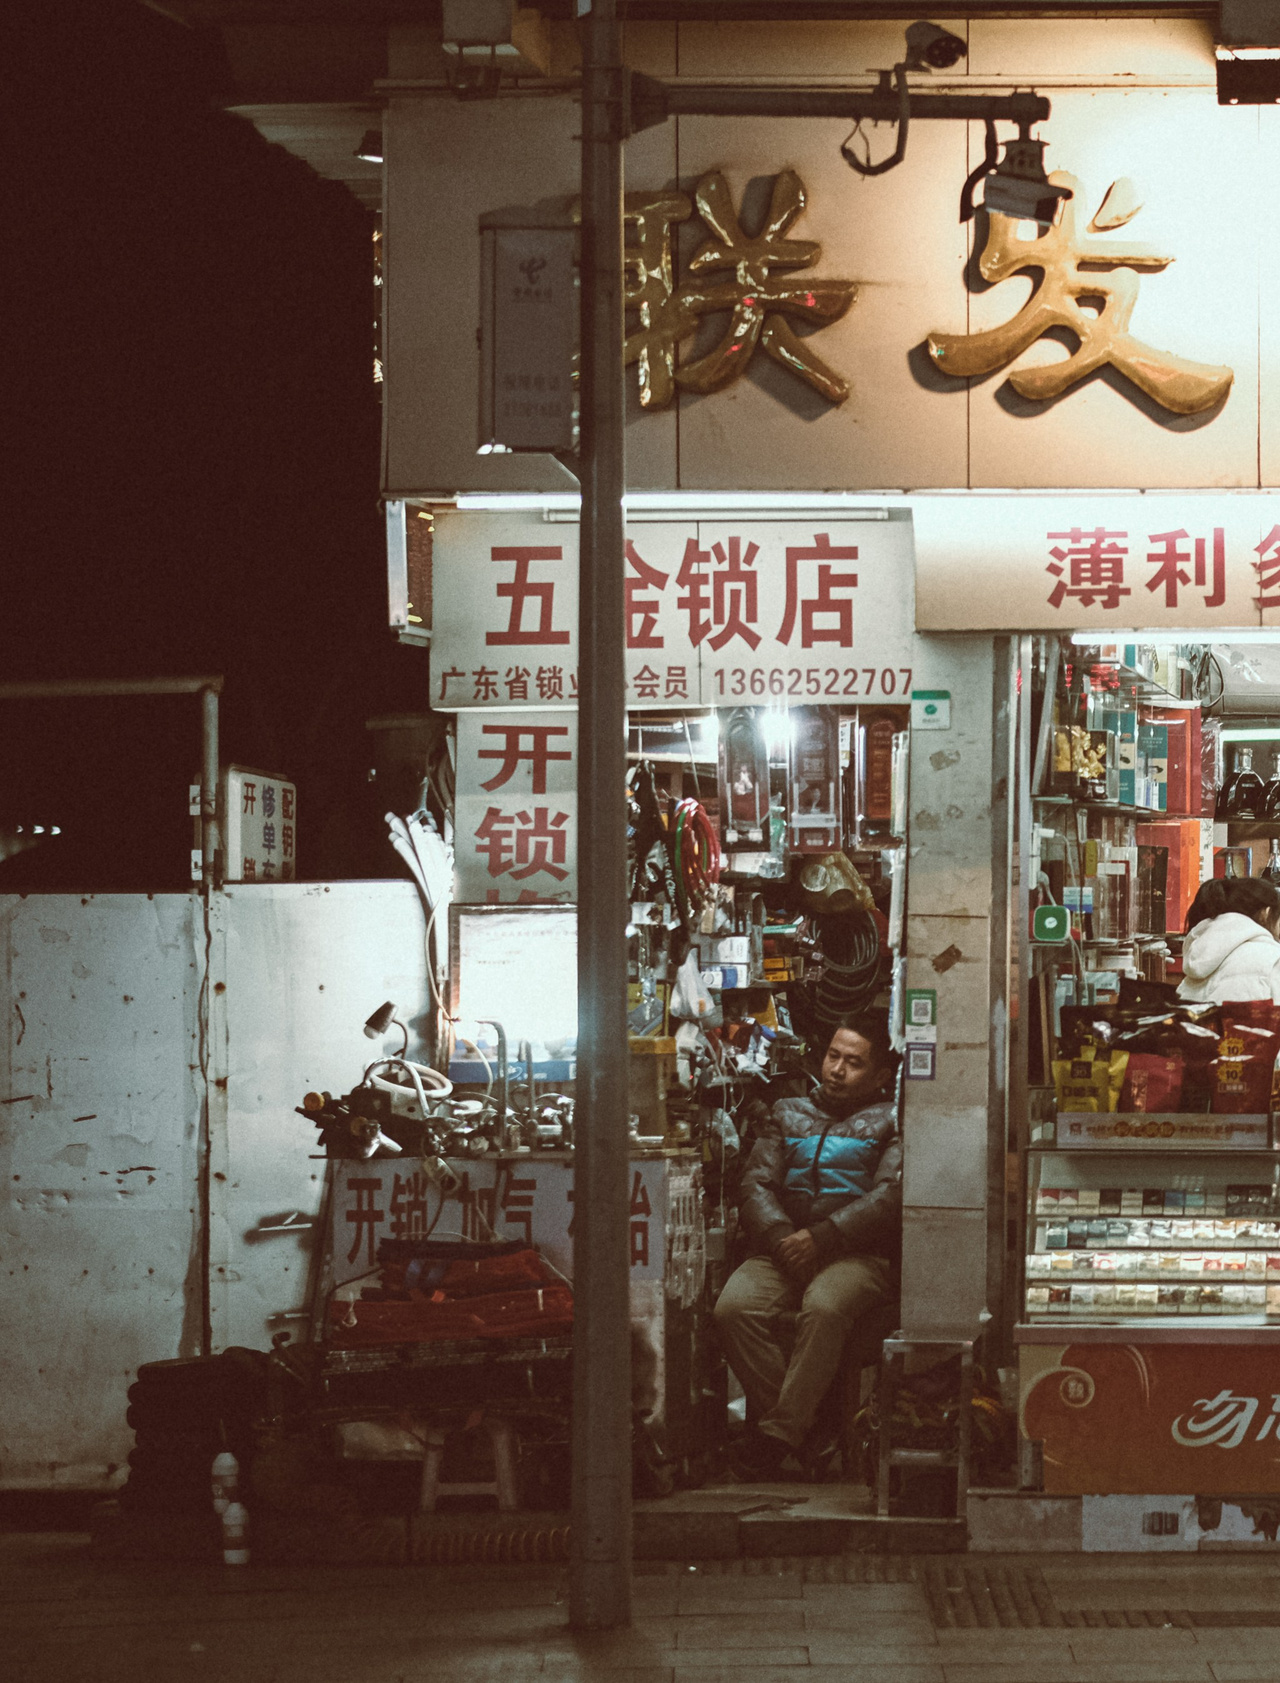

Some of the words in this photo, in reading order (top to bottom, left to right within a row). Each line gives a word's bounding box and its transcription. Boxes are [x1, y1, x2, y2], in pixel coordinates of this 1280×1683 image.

[438, 663, 690, 701] 广东省锁会员
[714, 667, 913, 696] 13662522707
[474, 724, 573, 902] 开锁
[1226, 1069, 1238, 1080] 10
